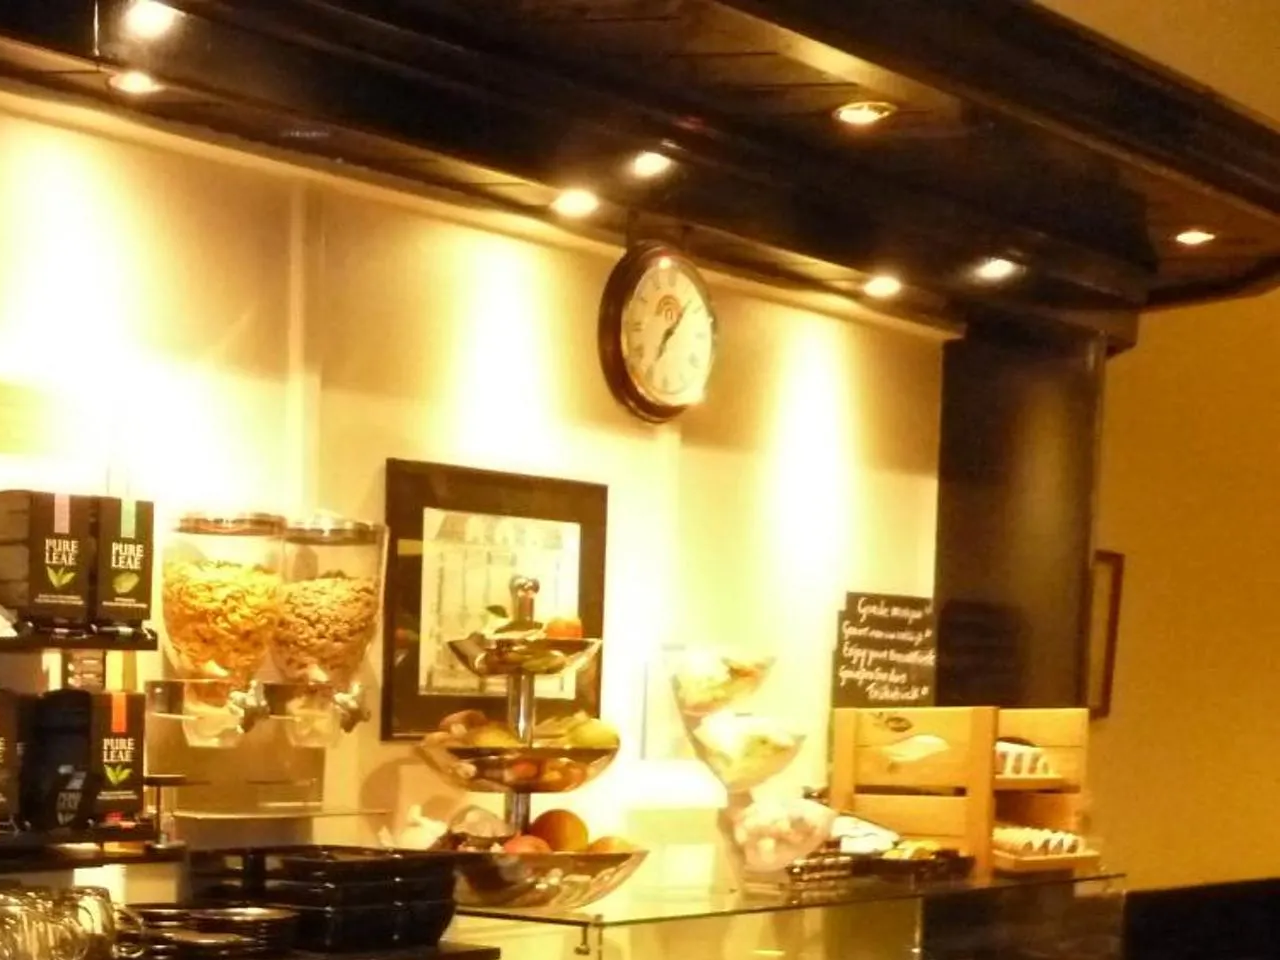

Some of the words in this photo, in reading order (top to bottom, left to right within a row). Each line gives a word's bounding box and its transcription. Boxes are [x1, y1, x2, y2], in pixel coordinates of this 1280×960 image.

[45, 538, 79, 554] PURE
[111, 541, 145, 558] PURE
[44, 552, 77, 566] LEAF
[111, 555, 142, 570] LEAF
[102, 737, 136, 750] PURE
[102, 749, 134, 763] LEAF
